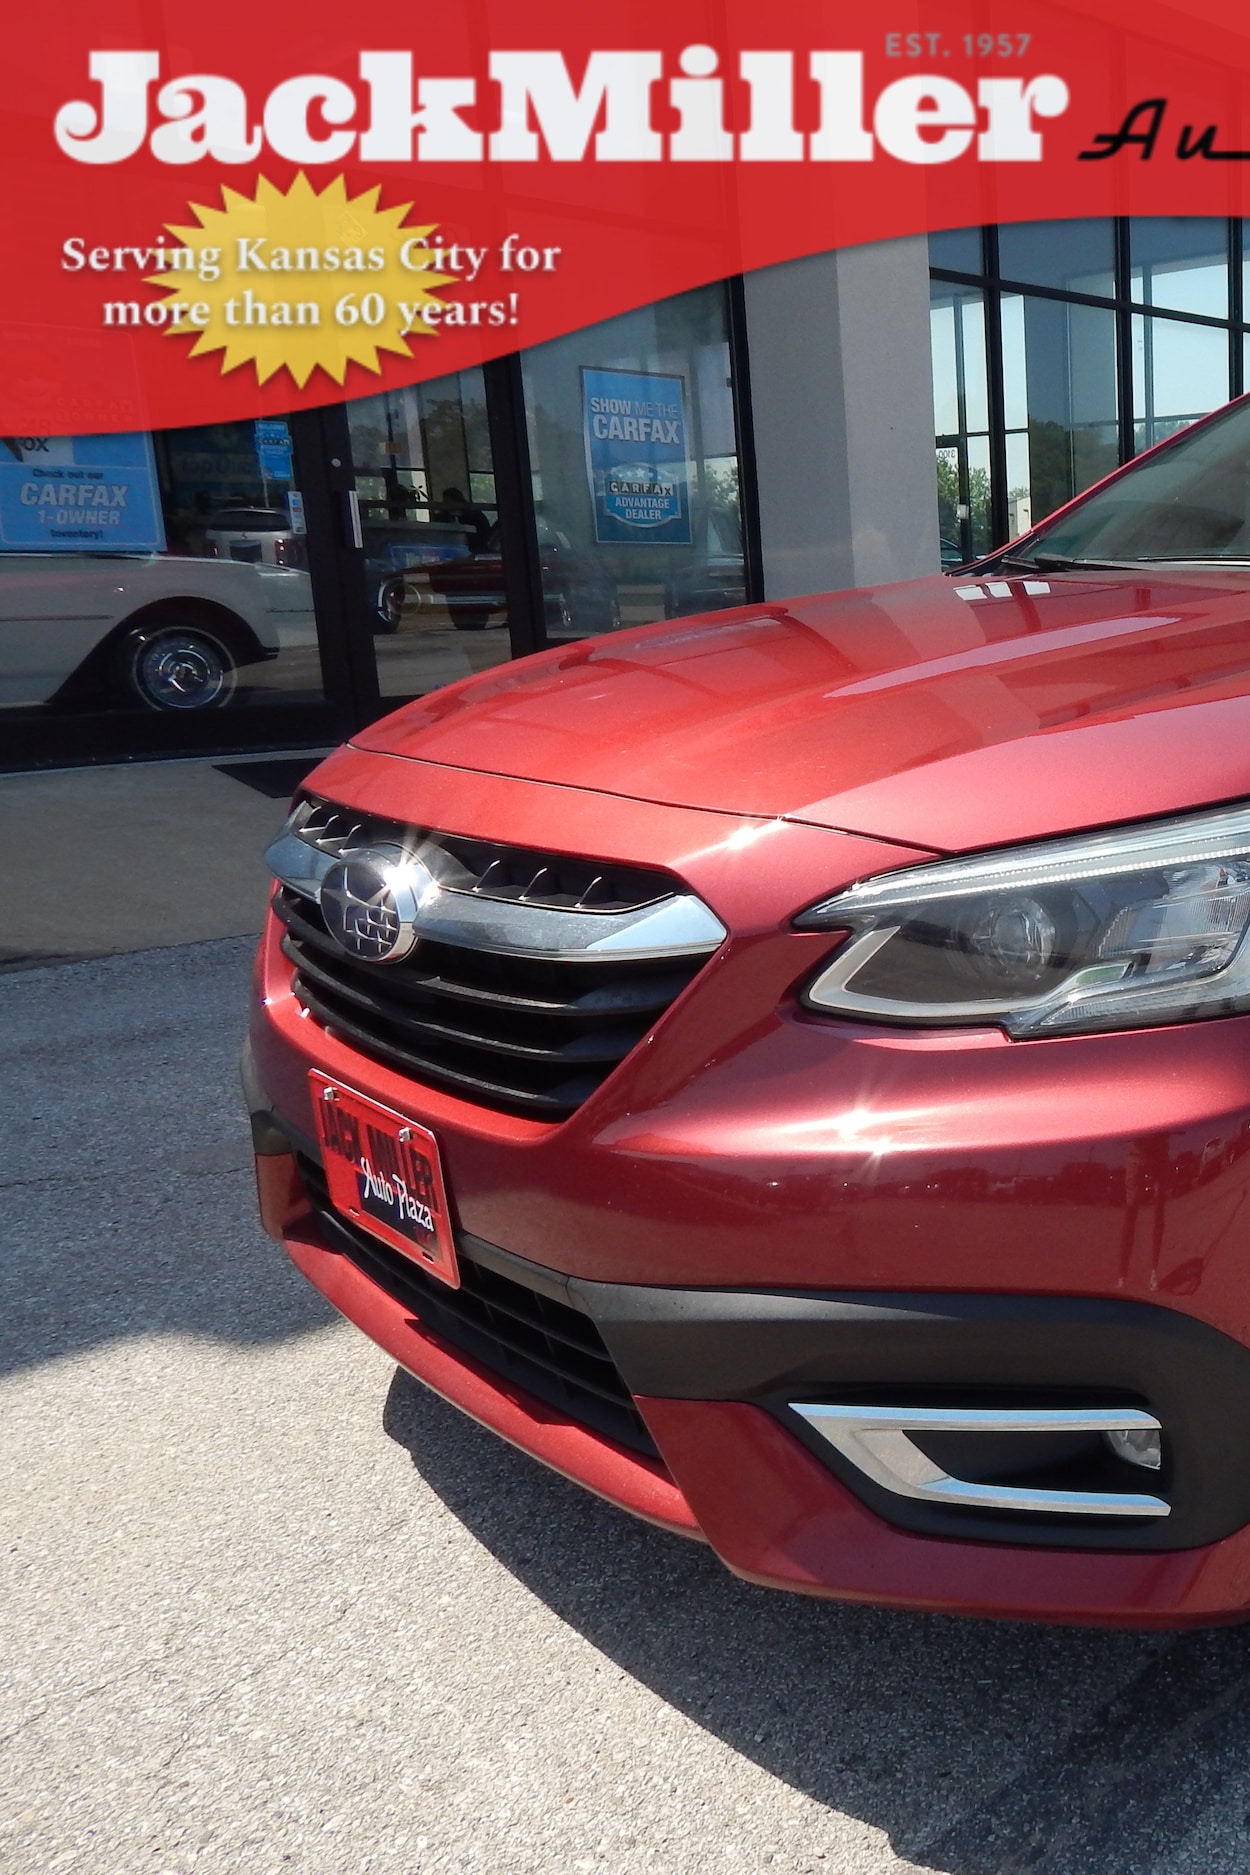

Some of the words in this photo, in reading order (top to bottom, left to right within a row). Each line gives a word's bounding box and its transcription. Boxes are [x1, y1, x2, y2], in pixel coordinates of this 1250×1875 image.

[591, 397, 631, 415] SHOW
[635, 402, 654, 417] ME
[656, 402, 678, 419] THE
[593, 415, 681, 444] CARFAX
[20, 482, 129, 507] CARFAX
[610, 482, 673, 496] CARFAX
[615, 497, 671, 509] ADVANTAGE
[37, 509, 121, 525] 1-OWNER
[625, 509, 663, 521] DEALER
[361, 1157, 394, 1205] Auto
[392, 1174, 434, 1232] Plaza
